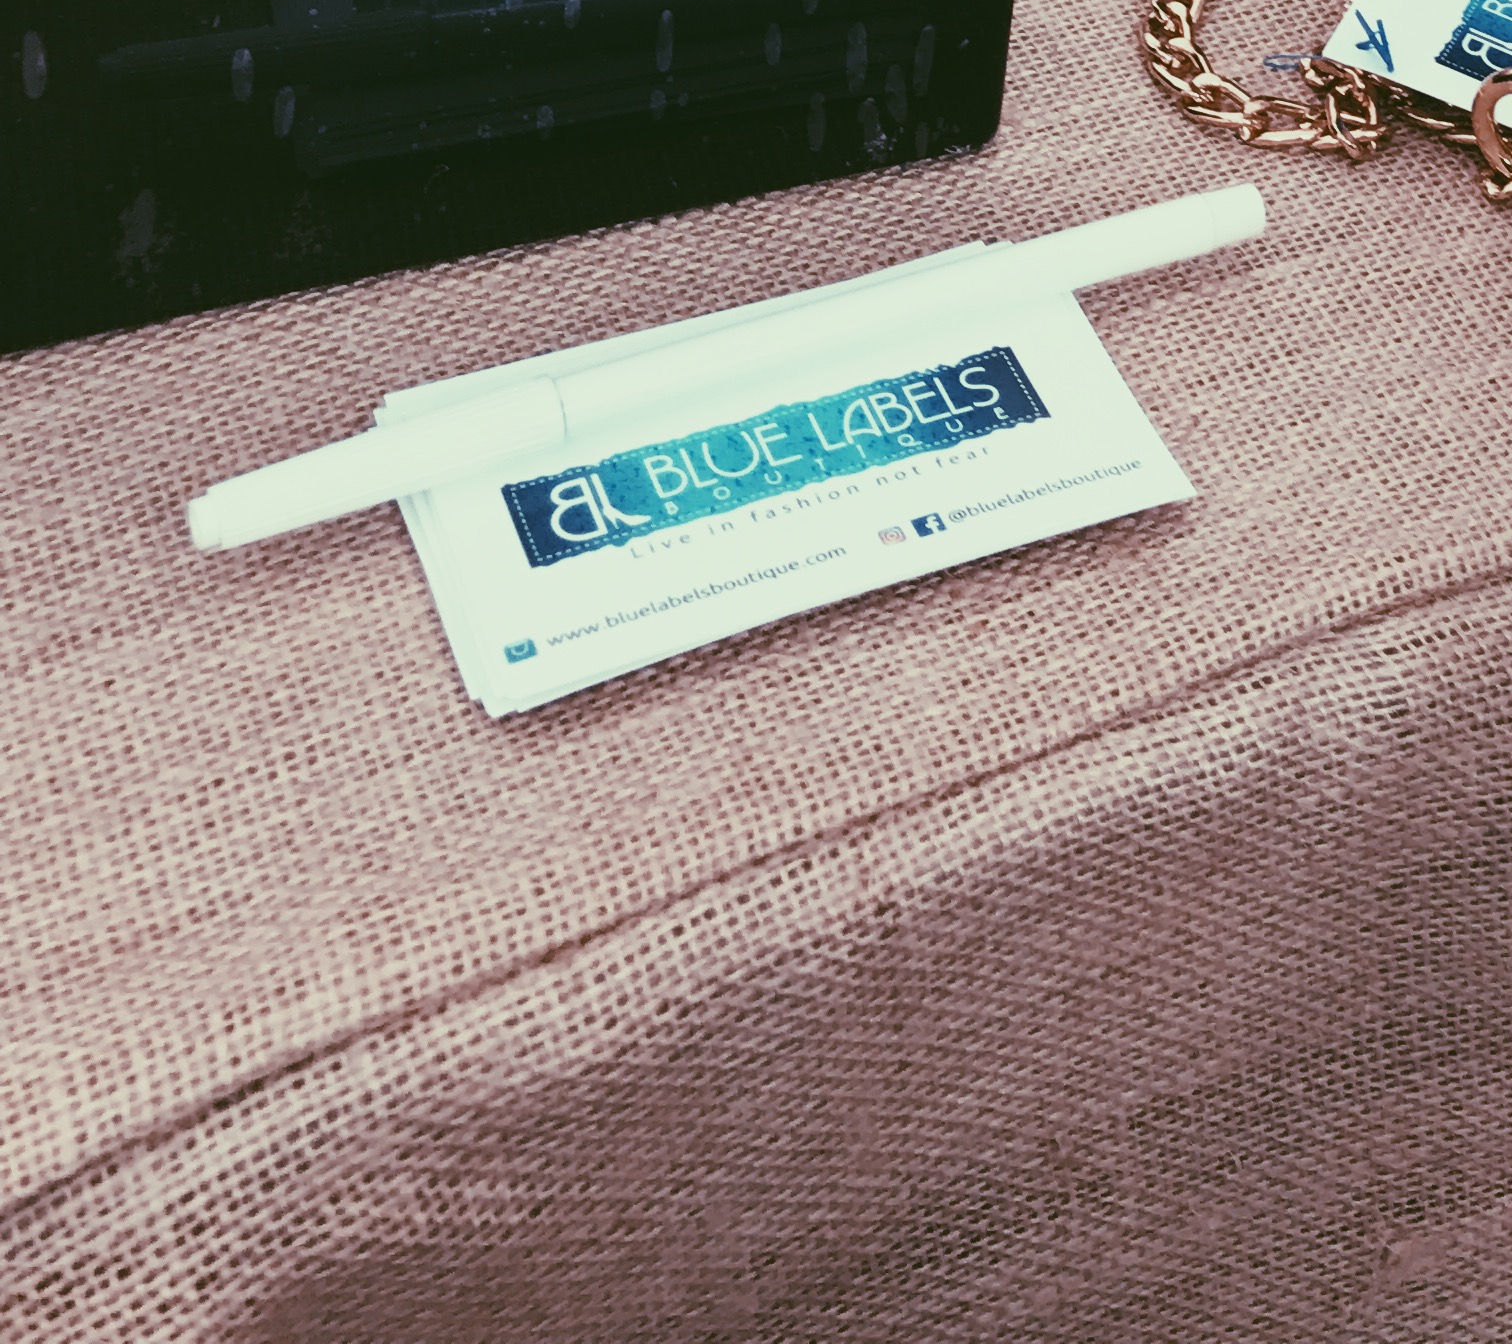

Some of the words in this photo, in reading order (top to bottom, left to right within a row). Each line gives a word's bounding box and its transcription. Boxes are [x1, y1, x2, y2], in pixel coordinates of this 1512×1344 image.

[643, 421, 804, 500] BLUE
[806, 365, 1002, 452] LABELS
[629, 534, 692, 560] Live
[707, 518, 736, 537] in
[749, 483, 862, 524] fashion
[875, 464, 920, 489] not
[934, 444, 992, 472] fear
[948, 457, 1144, 526] @bluelabelsboutique
[546, 543, 848, 648] www.bluelabelsboutique.com
